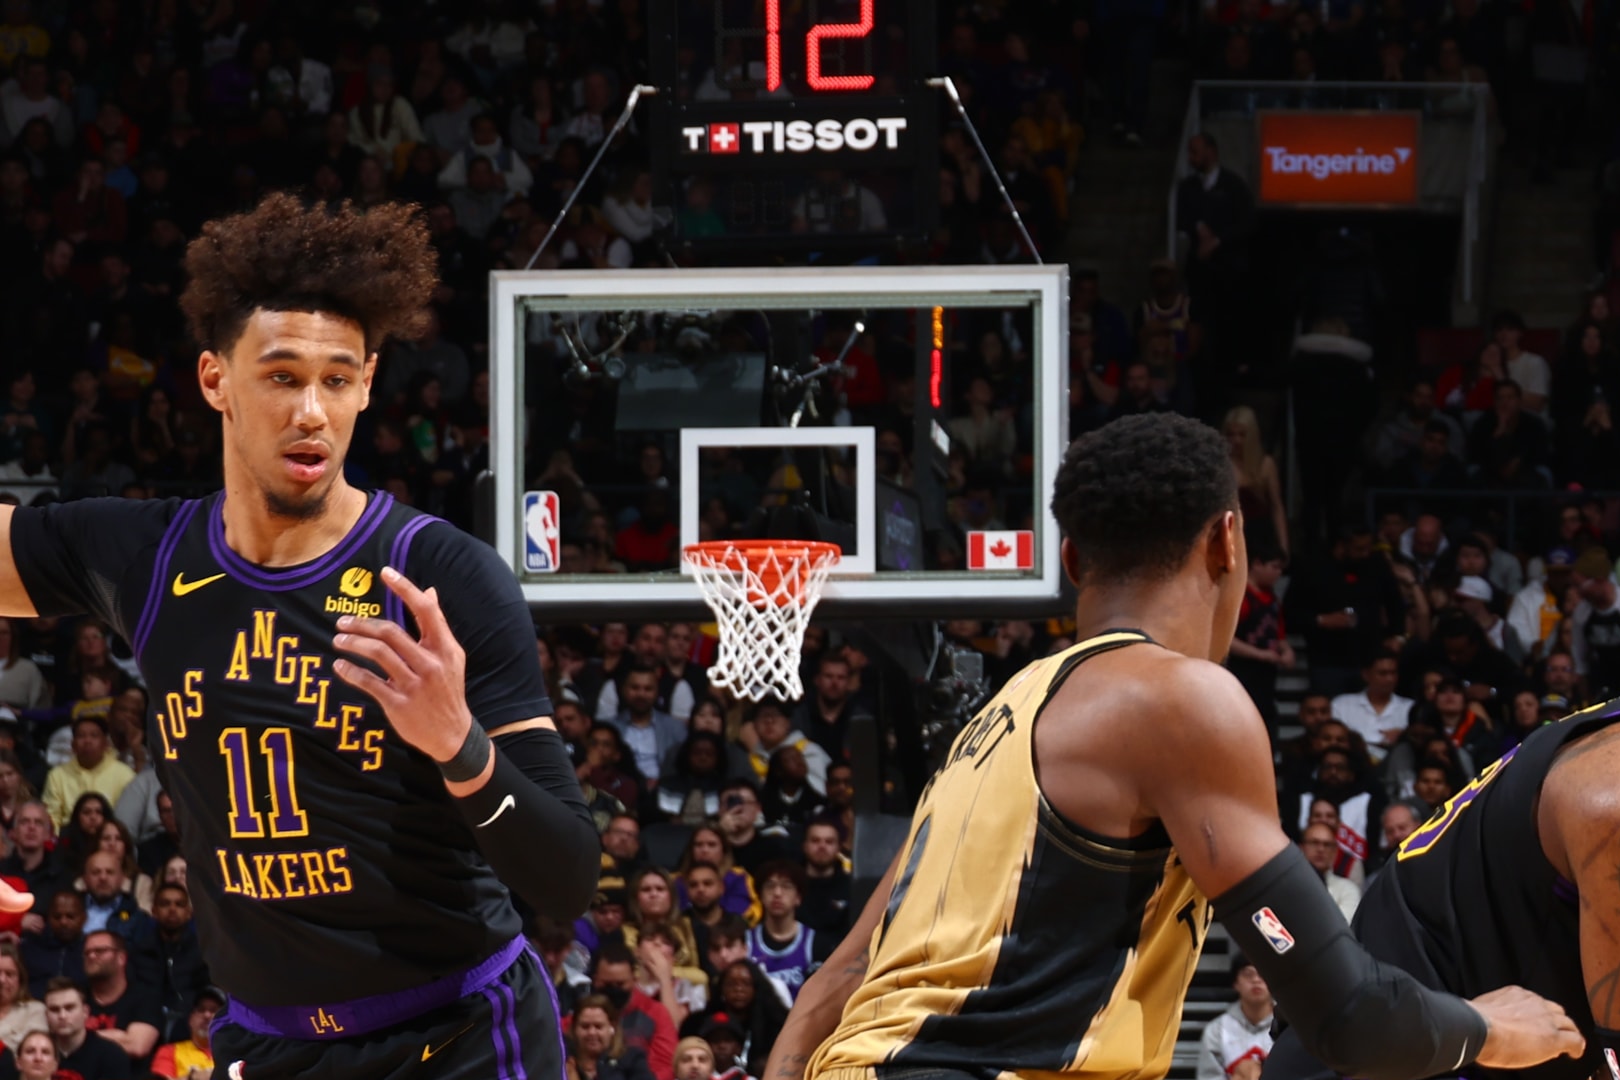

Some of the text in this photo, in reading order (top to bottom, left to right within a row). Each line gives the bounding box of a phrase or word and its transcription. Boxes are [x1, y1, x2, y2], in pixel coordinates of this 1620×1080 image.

[765, 0, 875, 92] 12
[742, 118, 907, 153] TISSOT
[1264, 146, 1396, 180] Tangerine
[324, 596, 381, 618] bibigo
[156, 610, 385, 771] LOS ANGELES
[218, 727, 309, 839] 11
[215, 847, 354, 899] LAKERS
[309, 1007, 345, 1034] LAL
